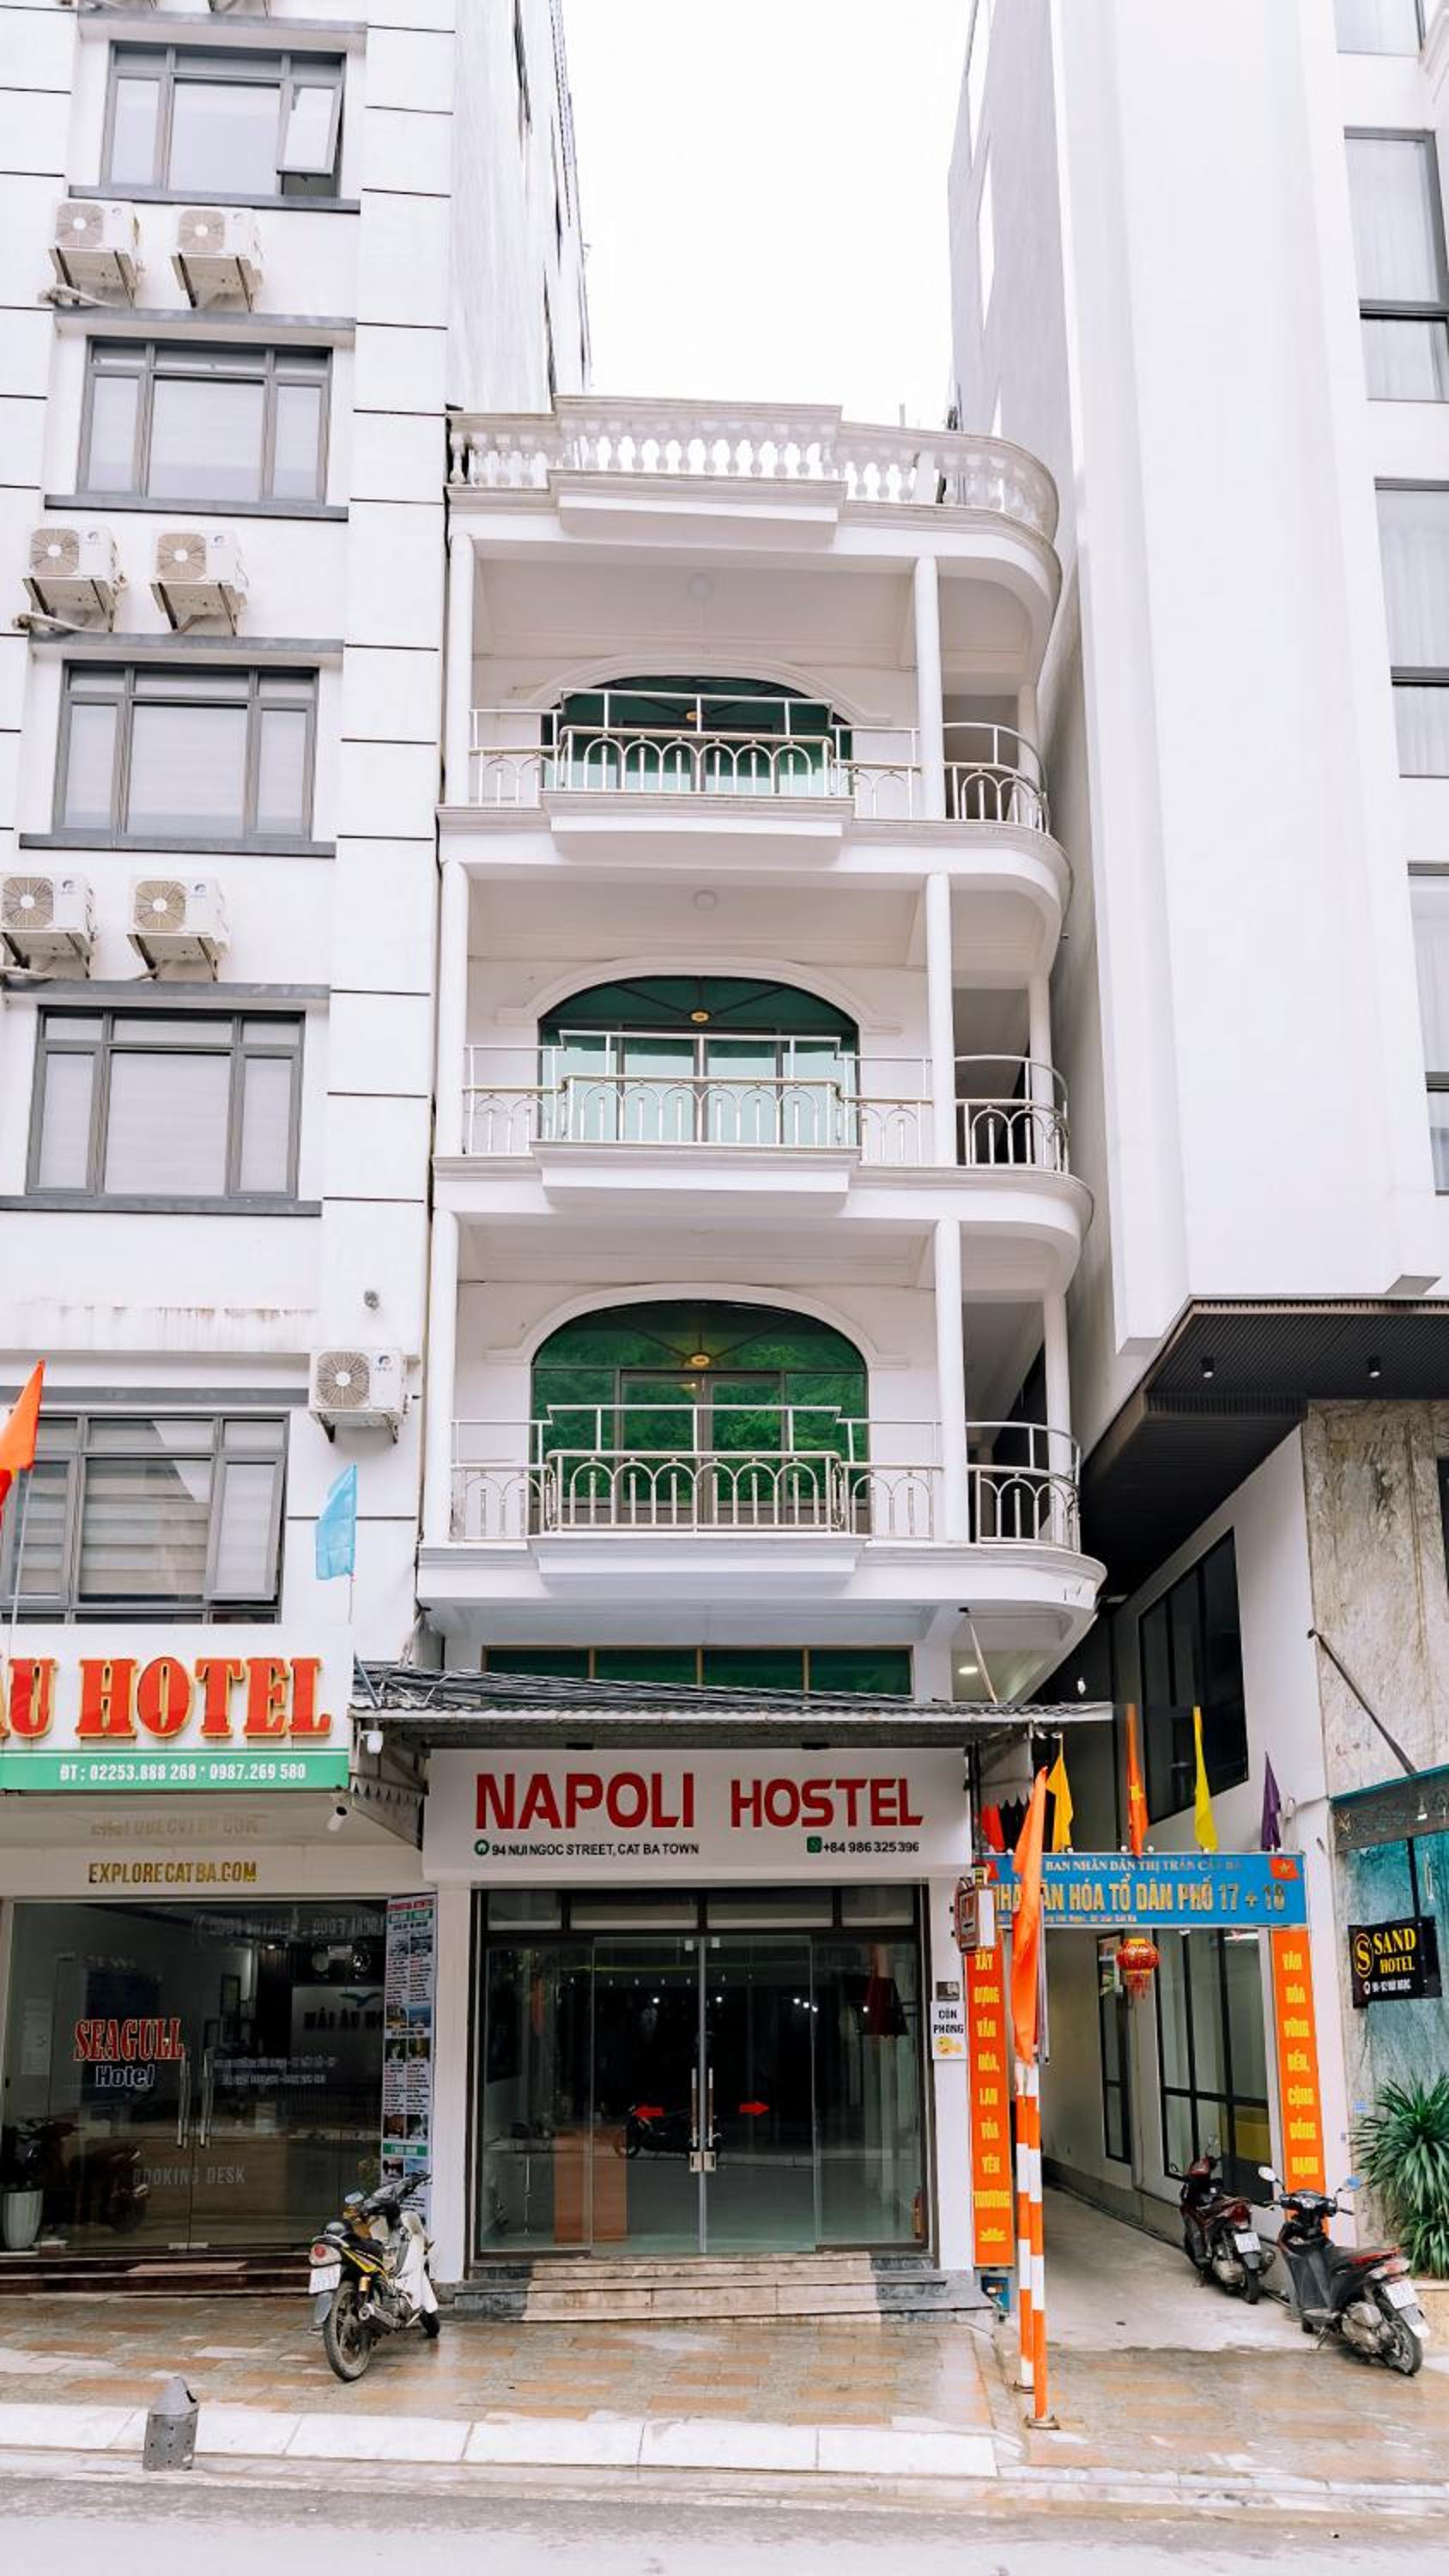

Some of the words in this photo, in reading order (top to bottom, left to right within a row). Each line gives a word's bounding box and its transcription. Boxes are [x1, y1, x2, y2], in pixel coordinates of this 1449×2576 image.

[0, 1656, 58, 1738] U
[76, 1656, 333, 1737] HOTEL
[172, 1764, 197, 1780] 268
[209, 1763, 276, 1780] 0987.269
[280, 1763, 306, 1780] 580
[476, 1772, 694, 1830] NAPOLI
[731, 1778, 924, 1827] HOSTEL
[492, 1844, 506, 1856] 94
[530, 1844, 563, 1856] NGOC
[566, 1844, 616, 1856] STREET,
[617, 1844, 640, 1856] CAT
[643, 1844, 659, 1856] BA
[664, 1843, 700, 1855] TOWN
[824, 1842, 846, 1853] +84
[848, 1841, 872, 1853] 986
[874, 1841, 897, 1852] 325
[898, 1841, 919, 1852] 396
[1046, 1861, 1070, 1871] BAN
[1074, 1858, 1107, 1871] NHÂN
[1110, 1858, 1135, 1871] DÂN
[1069, 1878, 1106, 1911] HÓA
[1109, 1873, 1131, 1911] TỔ
[1136, 1877, 1173, 1911] DÂN
[1178, 1875, 1213, 1911] PHỐ
[1218, 1883, 1238, 1911] 17
[1373, 1928, 1416, 1954] SAND
[1380, 1955, 1416, 1974] HOTEL
[73, 2018, 185, 2061] SEAGULL
[95, 2063, 155, 2088] Hotel
[205, 2164, 246, 2184] DESK
